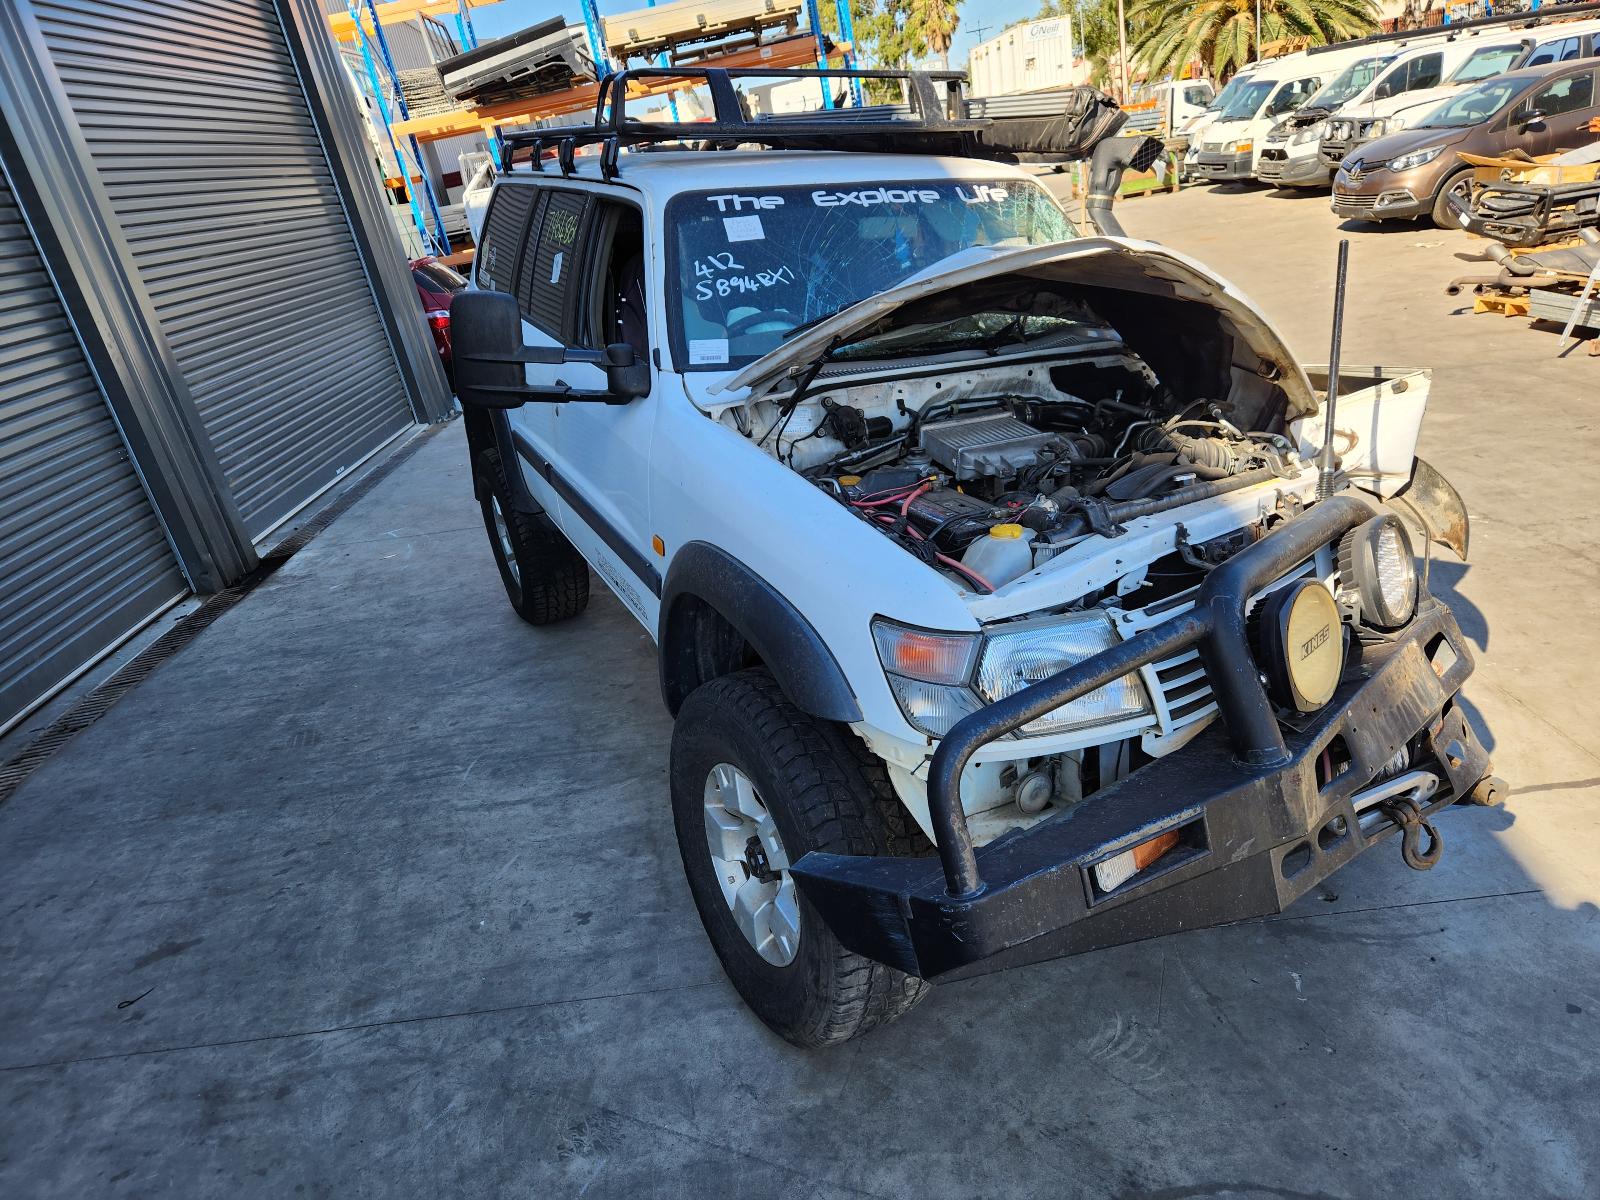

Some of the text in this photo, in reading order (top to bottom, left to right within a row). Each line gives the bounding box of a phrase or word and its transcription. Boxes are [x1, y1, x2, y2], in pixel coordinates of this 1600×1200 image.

[706, 184, 1009, 212] The Explore Life
[1300, 623, 1330, 661] KINGS
